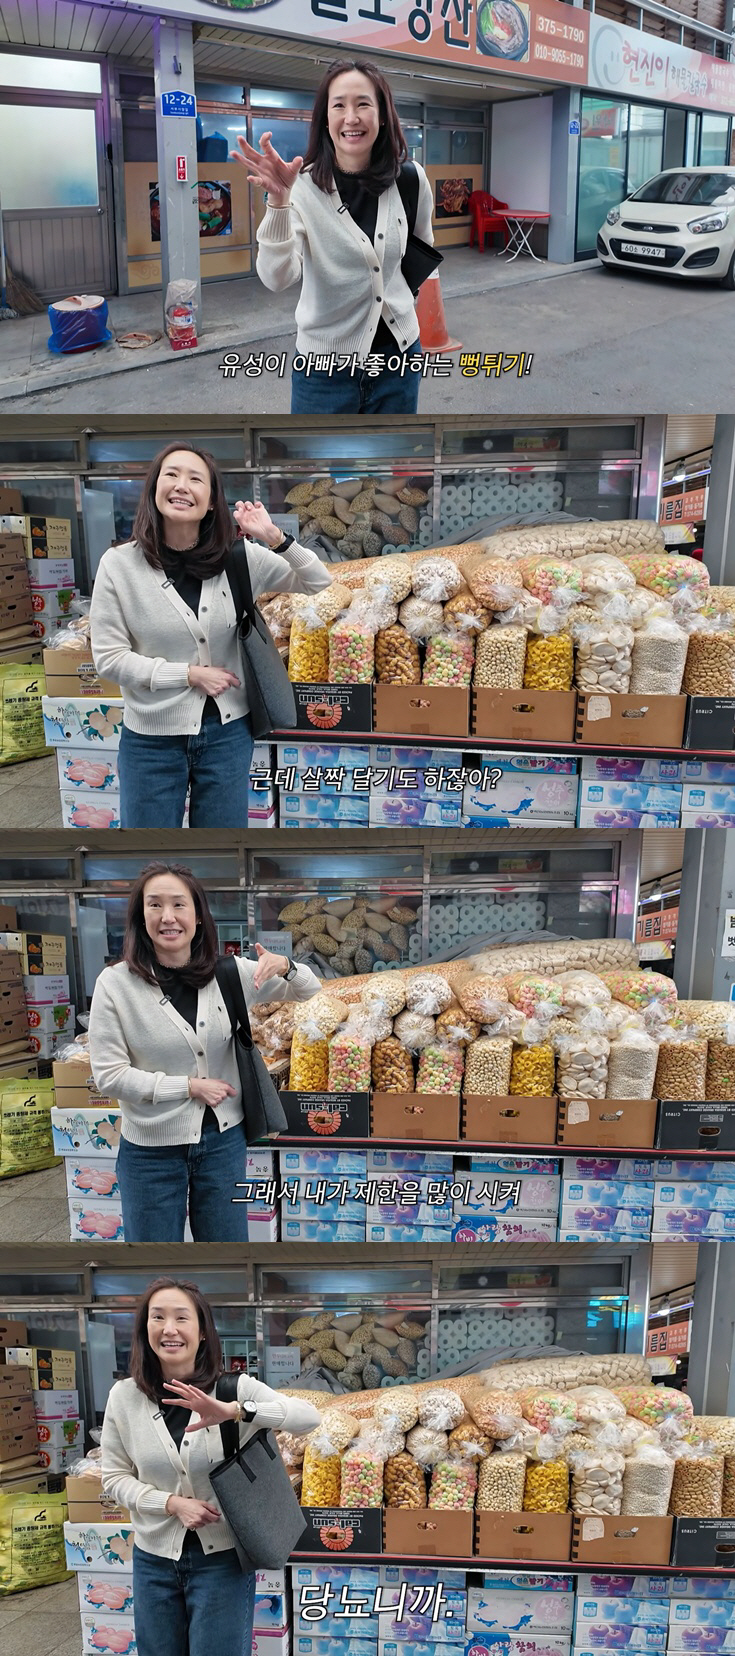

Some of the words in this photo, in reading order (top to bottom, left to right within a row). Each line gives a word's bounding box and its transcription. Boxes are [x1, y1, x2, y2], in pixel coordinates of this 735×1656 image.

[537, 17, 585, 43] 375-1790
[534, 43, 584, 68] 010-9055-1790
[622, 40, 670, 88] 현진이
[670, 65, 708, 97] 해물칼국수
[164, 94, 193, 105] 12-24
[641, 246, 661, 256] 9947
